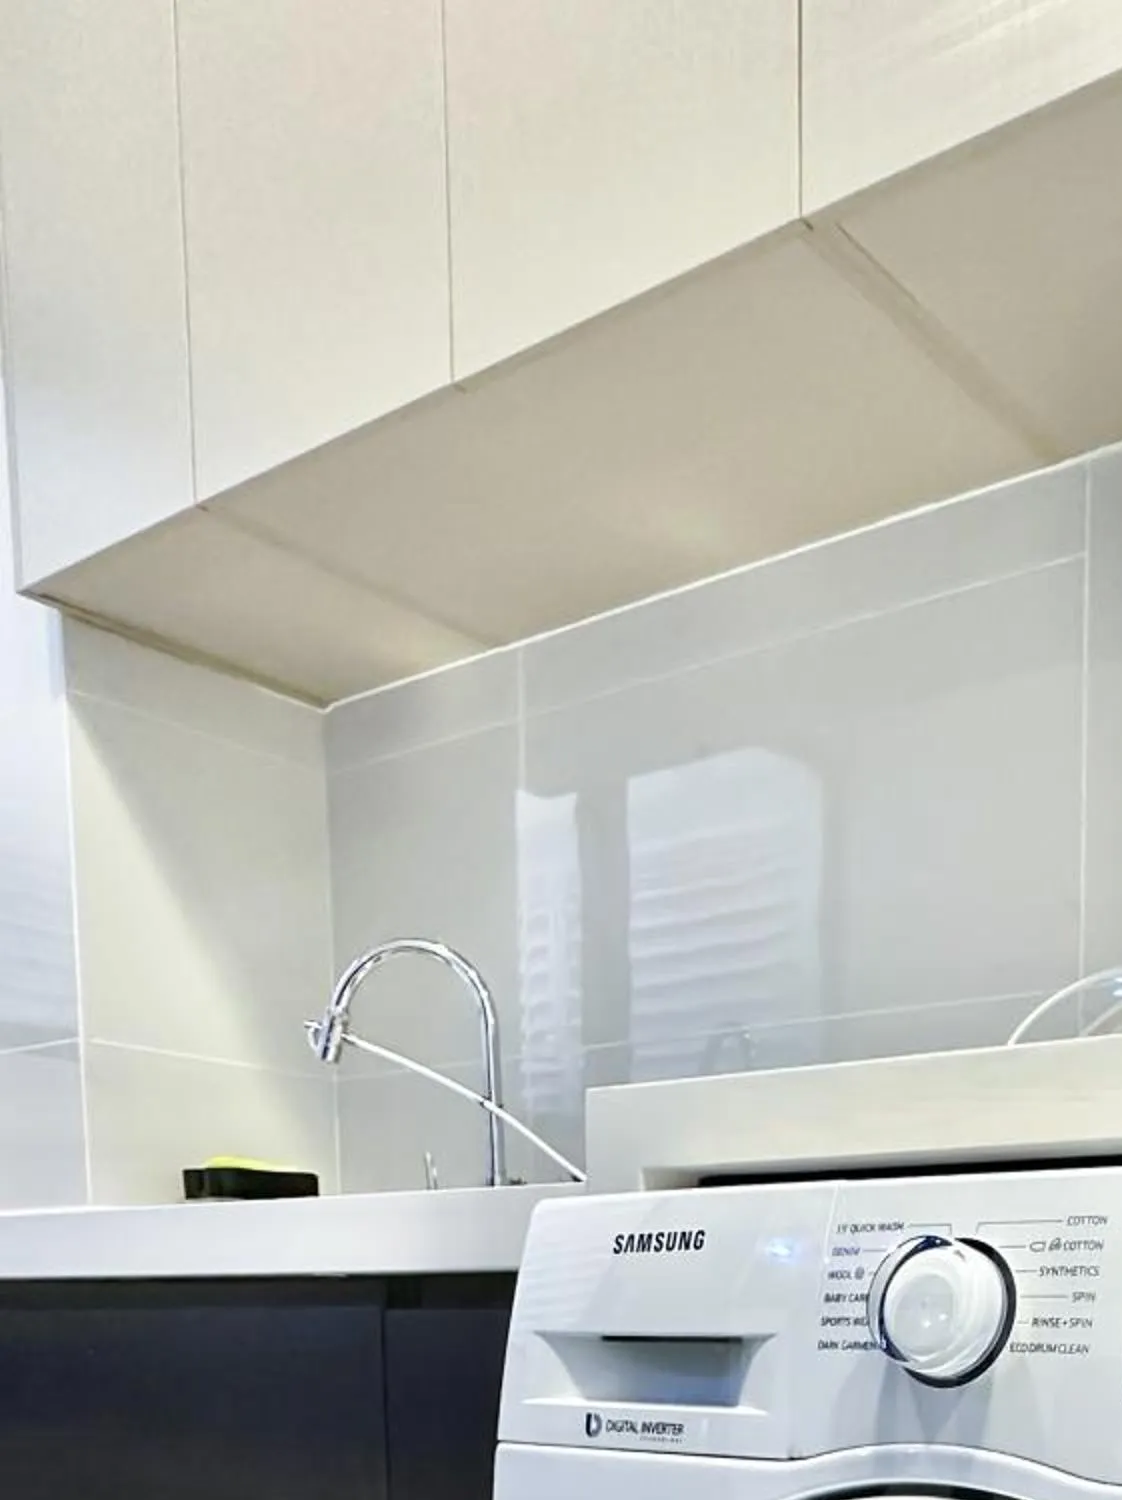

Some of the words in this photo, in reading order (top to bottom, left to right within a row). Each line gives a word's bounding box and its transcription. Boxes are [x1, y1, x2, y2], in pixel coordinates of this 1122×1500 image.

[1067, 1215, 1108, 1226] COTTON
[613, 1229, 706, 1255] SAMSUNG
[1063, 1241, 1105, 1252] COTTON
[1039, 1265, 1100, 1277] SYNTHETICS
[1072, 1292, 1097, 1303] SPIN
[606, 1419, 638, 1434] DIGITAL
[641, 1421, 685, 1435] INVERTER
